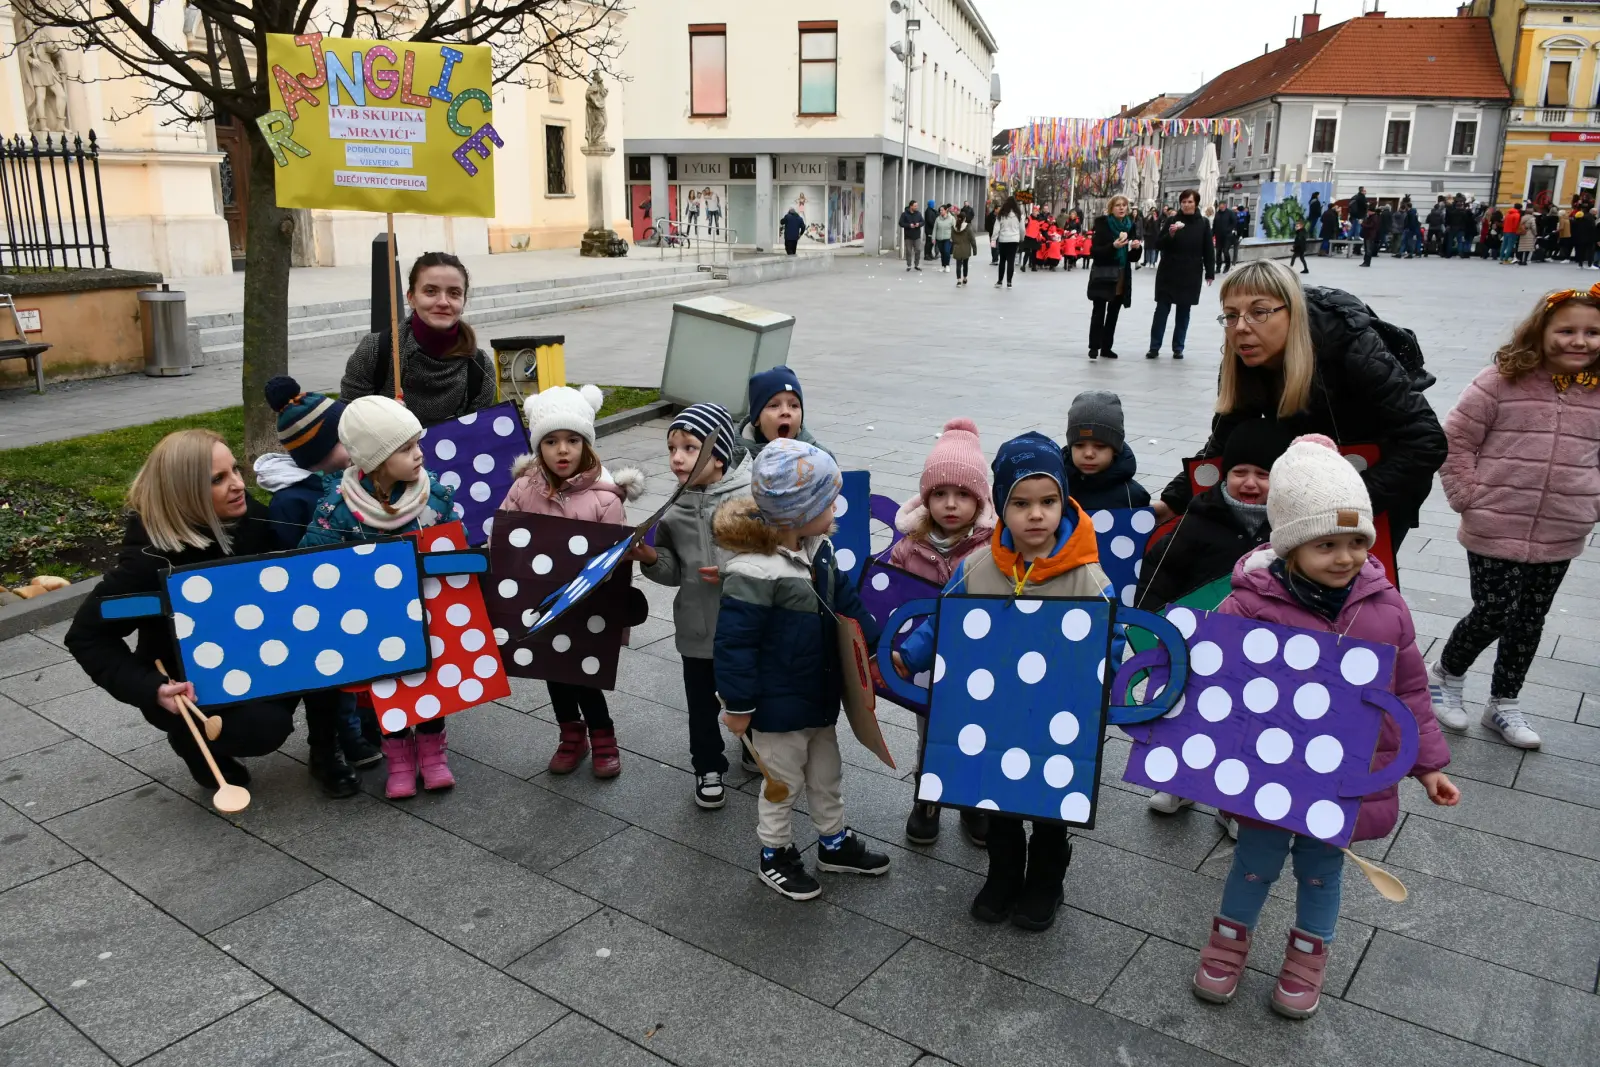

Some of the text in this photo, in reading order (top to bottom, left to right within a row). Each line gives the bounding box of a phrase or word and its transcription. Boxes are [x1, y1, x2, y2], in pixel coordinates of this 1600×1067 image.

[255, 32, 505, 177] RAJNGLICE
[331, 108, 424, 122] IV.B SKUPINA
[346, 145, 411, 155] PODRUČNI ODJEL
[359, 159, 400, 167] VJEVERICA
[691, 162, 721, 174] YUKI
[791, 162, 822, 174] YUKI
[336, 174, 426, 187] DJEČJI VRTIĆ CIPELICA
